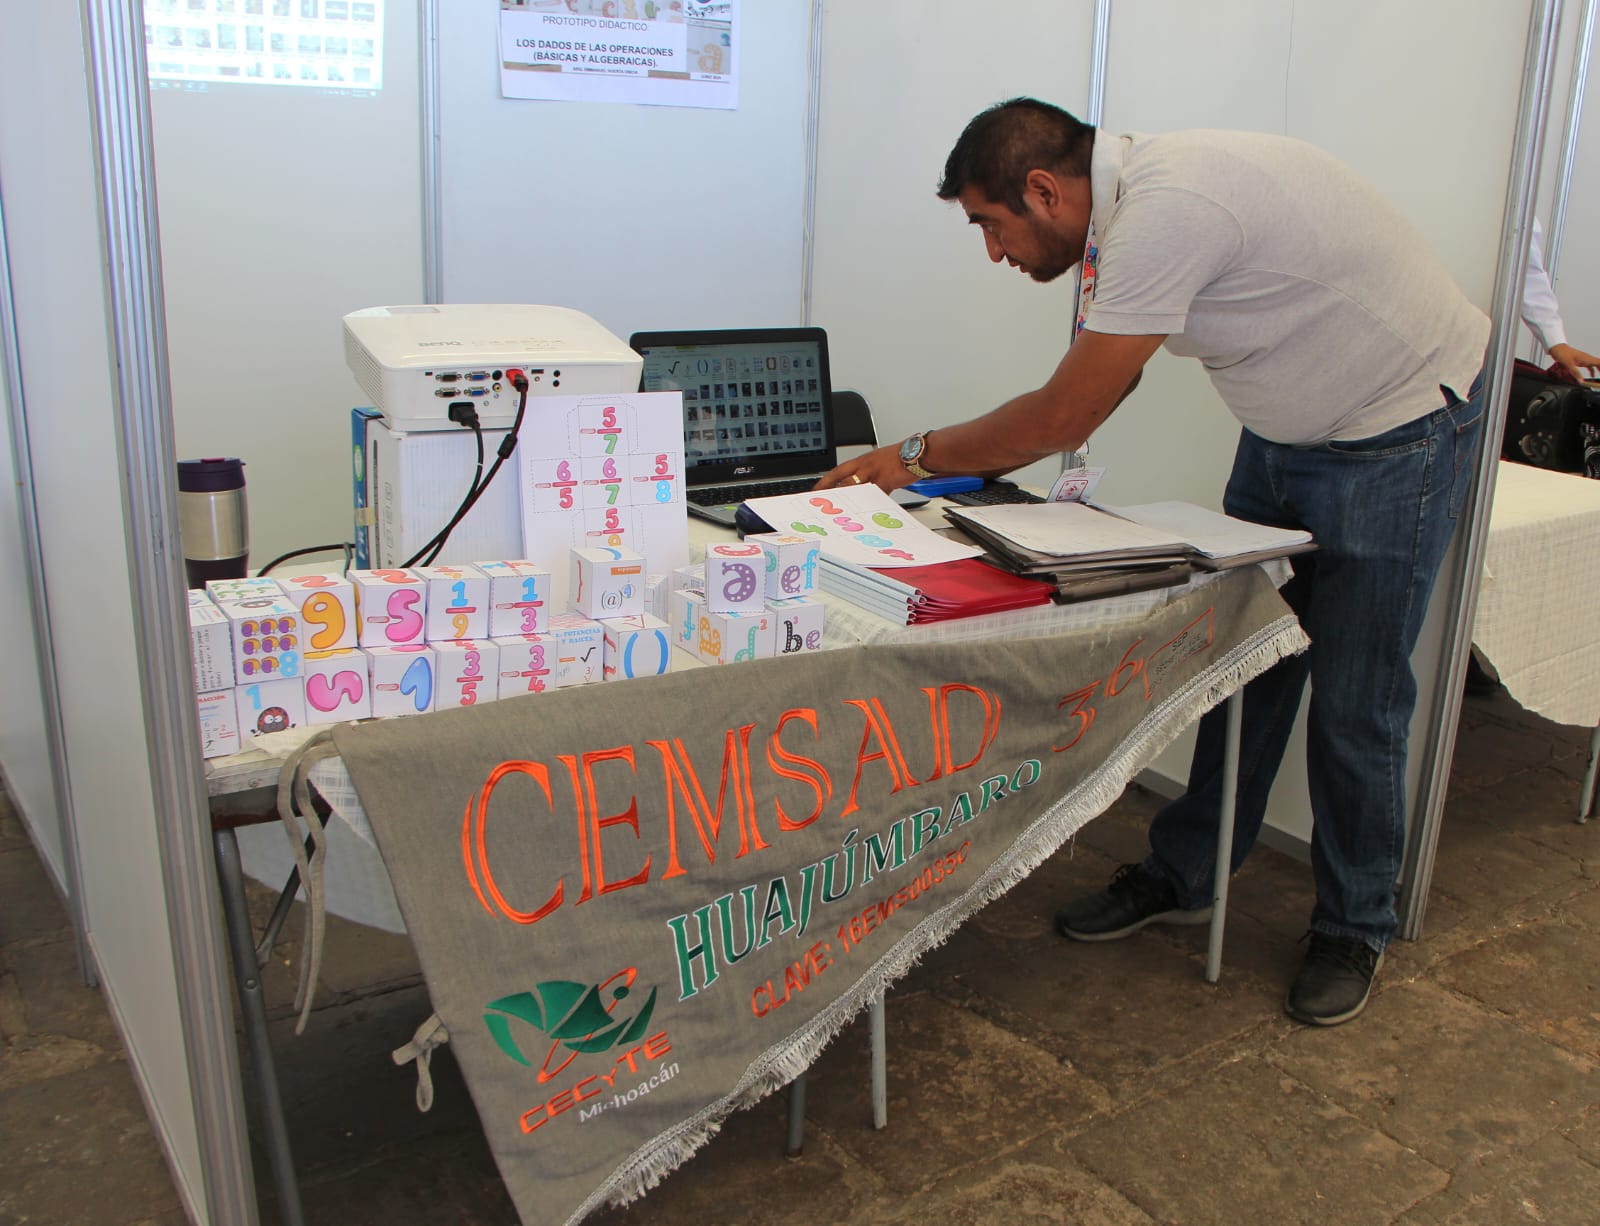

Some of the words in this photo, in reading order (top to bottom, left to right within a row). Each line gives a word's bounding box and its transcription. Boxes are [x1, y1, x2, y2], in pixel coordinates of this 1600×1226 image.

[543, 16, 597, 28] PROTOTIPO
[599, 20, 648, 31] DIDACTICO
[516, 39, 536, 48] LOS
[538, 40, 572, 50] DADOS
[574, 43, 587, 51] DE
[589, 44, 607, 52] LAS
[609, 45, 674, 57] OPERACIONES
[581, 54, 587, 63] Y
[602, 407, 616, 427] 5
[604, 434, 618, 454] 7
[556, 460, 571, 481] 6
[602, 458, 616, 478] 6
[655, 454, 668, 474] 5
[560, 488, 573, 508] 5
[605, 484, 620, 504] 7
[656, 480, 671, 502] 8
[606, 508, 619, 528] 5
[302, 592, 345, 649] 9
[279, 651, 298, 677] 8
[246, 684, 262, 710] 1
[462, 682, 1002, 926] CEMSAD
[666, 758, 1042, 1003] HUAJÚMBARO
[751, 941, 834, 1018] CLAVE:
[520, 1031, 672, 1135] CECYTE
